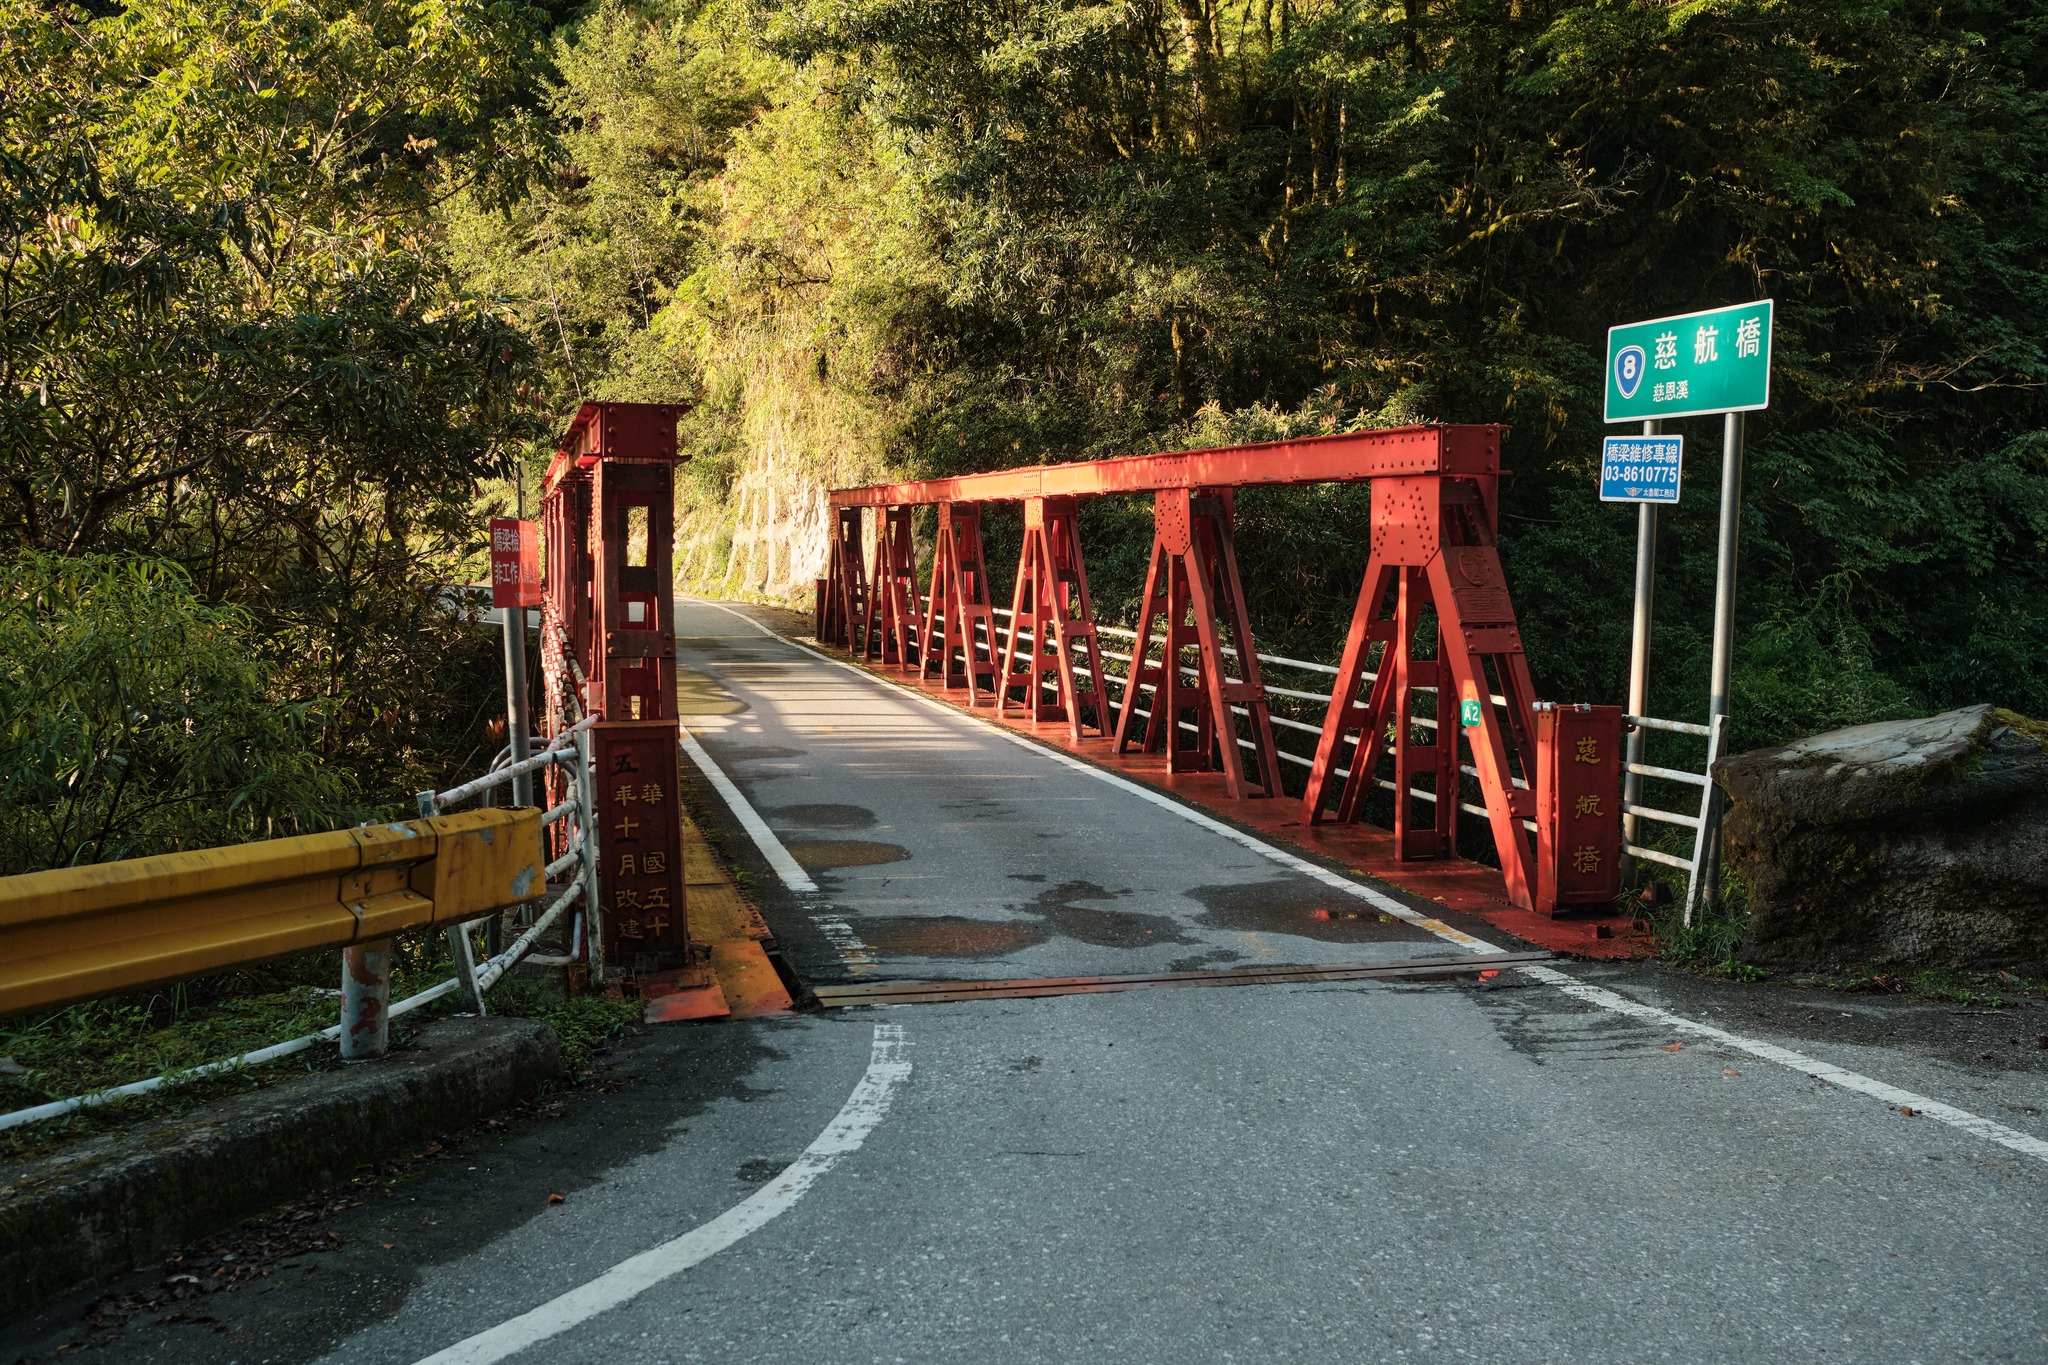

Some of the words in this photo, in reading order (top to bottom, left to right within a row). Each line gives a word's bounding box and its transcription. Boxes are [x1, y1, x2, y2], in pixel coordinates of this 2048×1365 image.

[1654, 316, 1761, 370] 慈航橋
[1623, 354, 1637, 380] 8
[1652, 380, 1689, 403] 慈恩溪
[1607, 443, 1678, 464] 橋梁維修專線
[1605, 465, 1677, 483] 03-8610775
[1463, 706, 1479, 722] A2
[1573, 736, 1603, 874] 慈航橋
